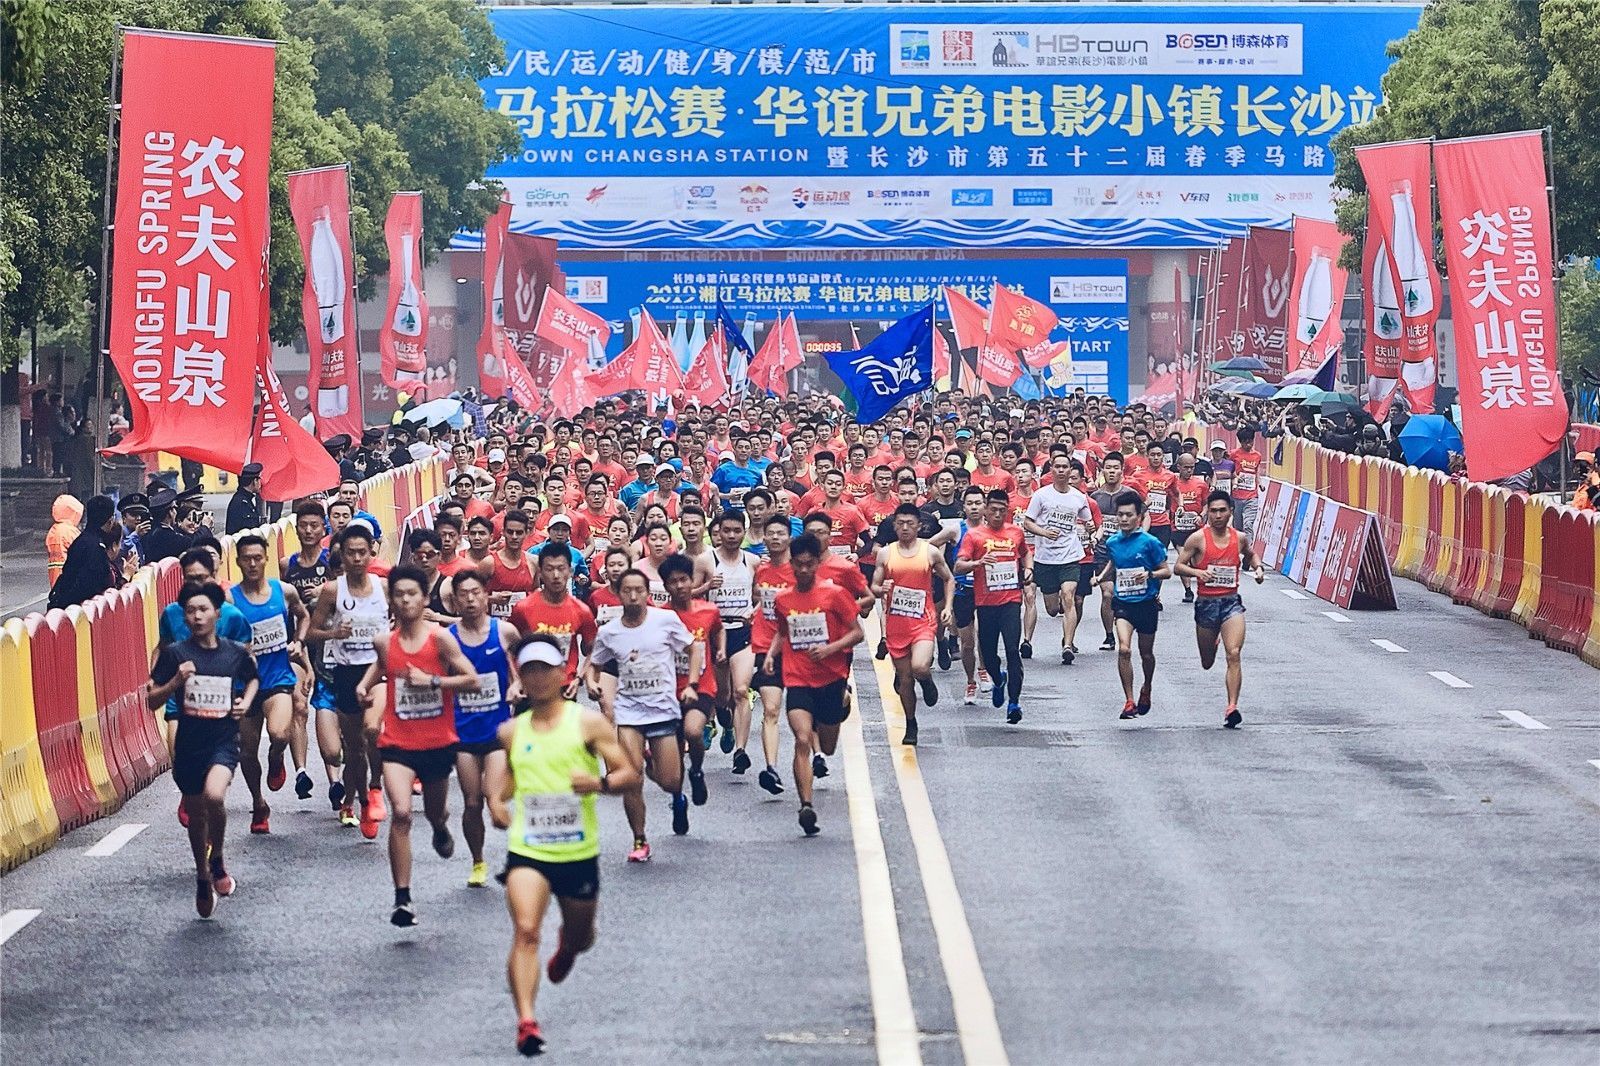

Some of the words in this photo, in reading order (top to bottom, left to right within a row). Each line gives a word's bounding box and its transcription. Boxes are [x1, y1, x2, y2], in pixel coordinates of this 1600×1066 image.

[1231, 34, 1290, 49] 博森体育
[585, 148, 710, 163] CHANGSHA
[715, 147, 809, 163] STATION
[137, 131, 176, 254] SPRING
[168, 136, 246, 408] 农夫山泉
[131, 269, 168, 402] NONGFU
[1071, 341, 1112, 353] TART
